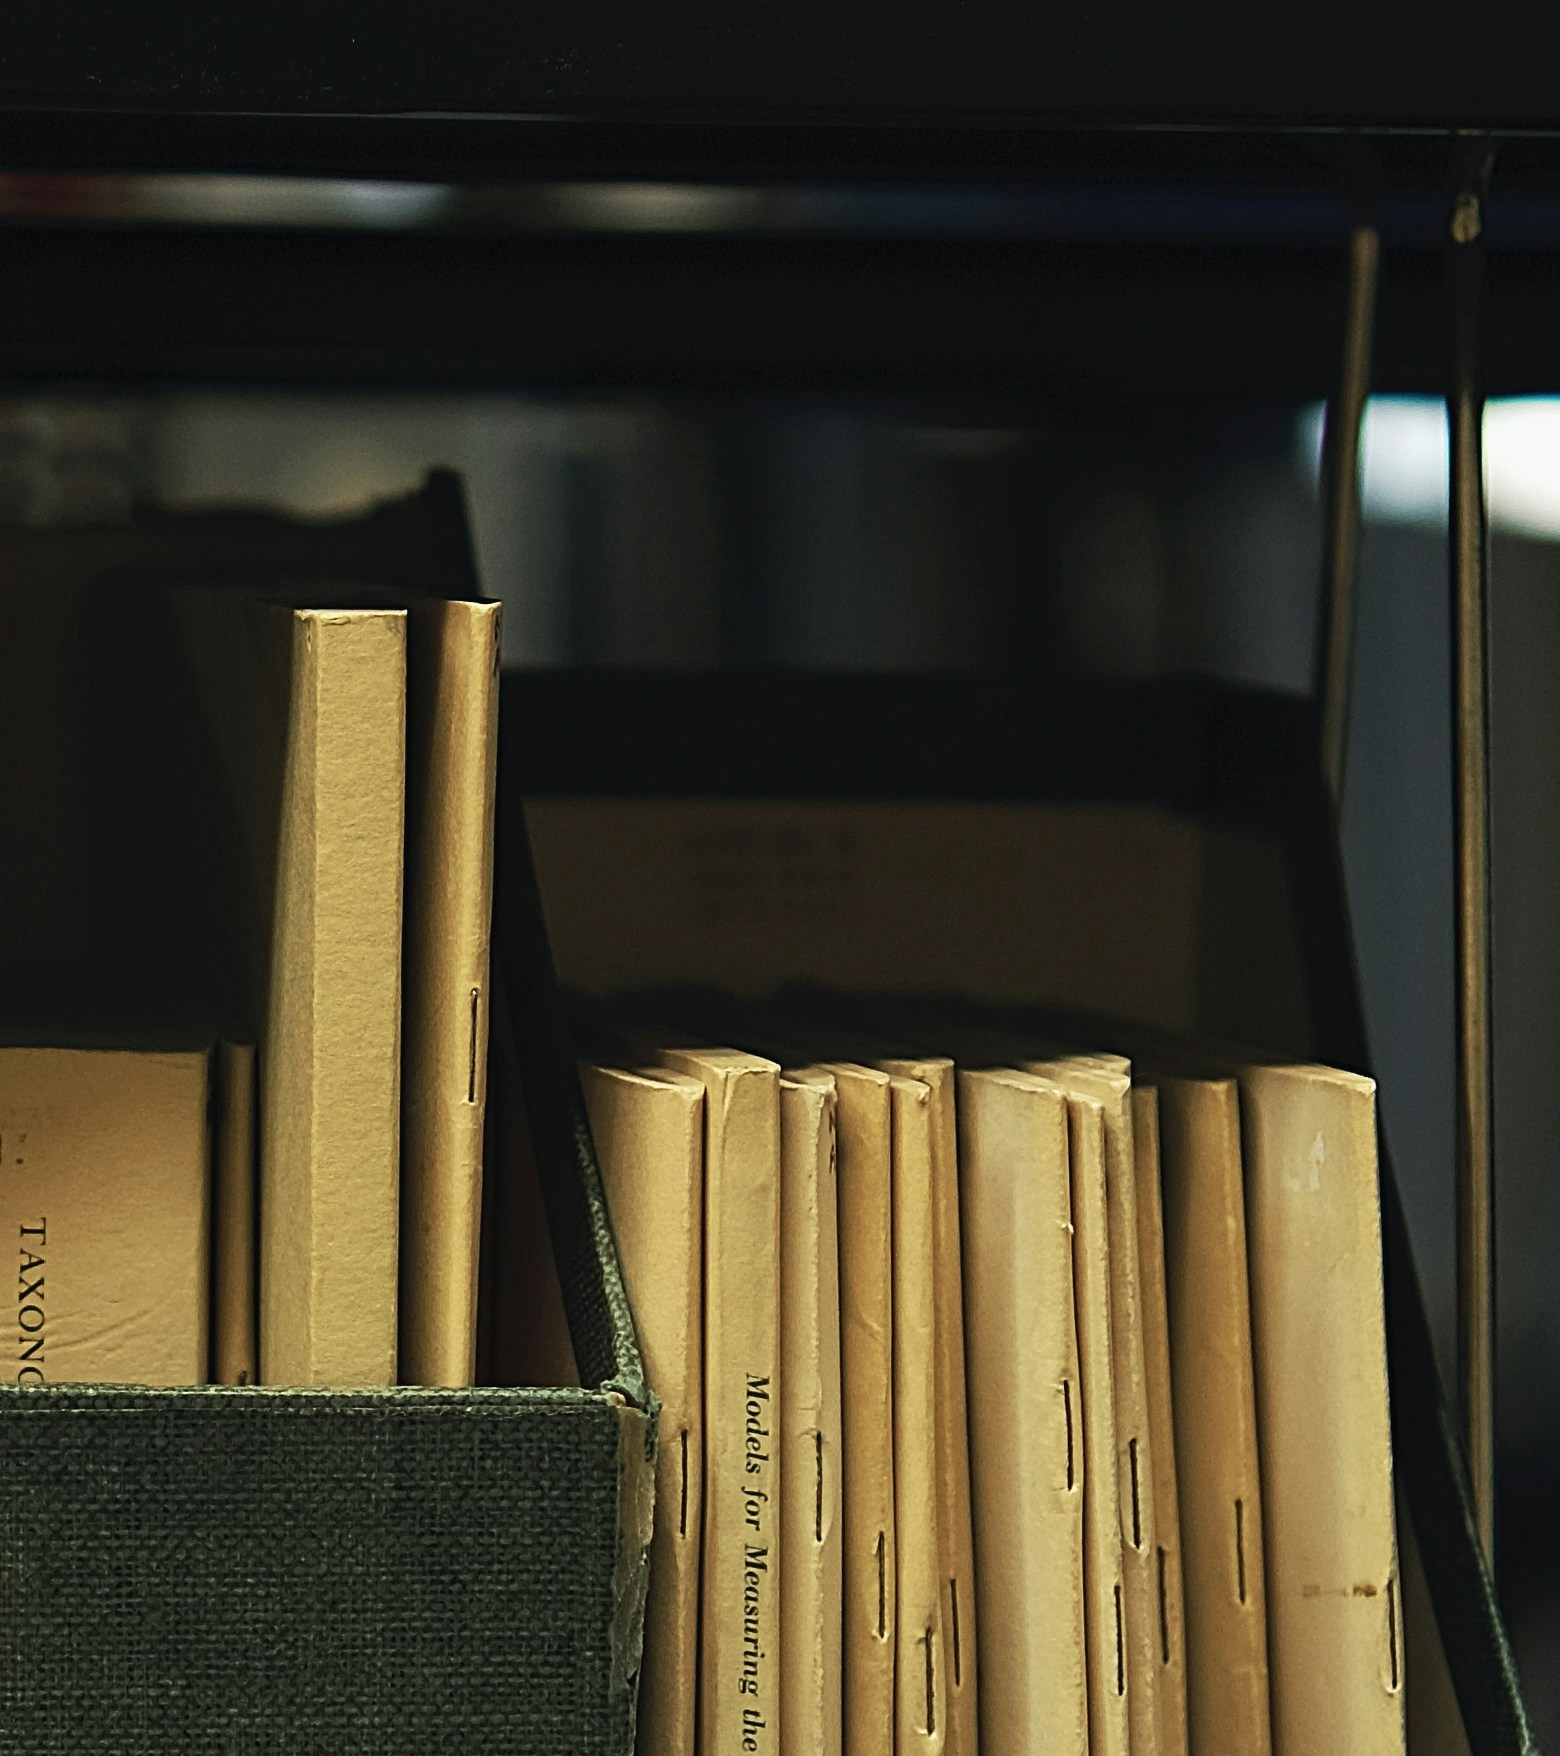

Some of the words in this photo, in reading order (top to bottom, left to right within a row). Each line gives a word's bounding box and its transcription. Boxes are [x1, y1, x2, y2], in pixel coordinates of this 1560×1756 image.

[745, 1372, 771, 1475] Models
[740, 1486, 769, 1532] for
[738, 1543, 770, 1697] Measuring
[742, 1708, 766, 1752] the
